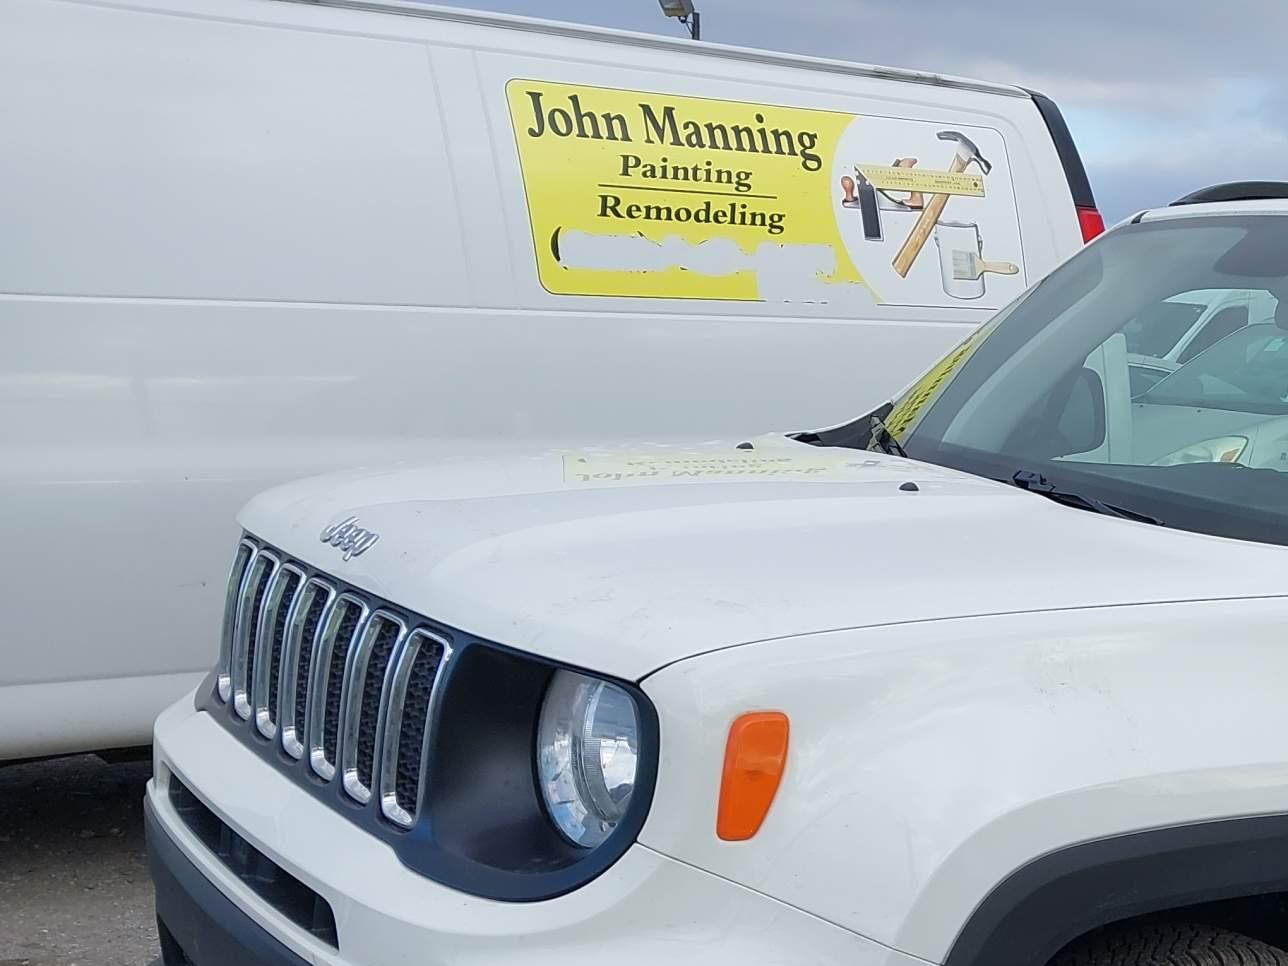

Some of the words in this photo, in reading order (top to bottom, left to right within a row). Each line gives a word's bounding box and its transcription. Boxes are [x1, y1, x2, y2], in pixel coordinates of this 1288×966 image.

[526, 91, 632, 142] John
[638, 103, 822, 171] Manning
[619, 154, 752, 192] Painting
[597, 194, 786, 234] Remodeling
[320, 516, 379, 561] Jeep
